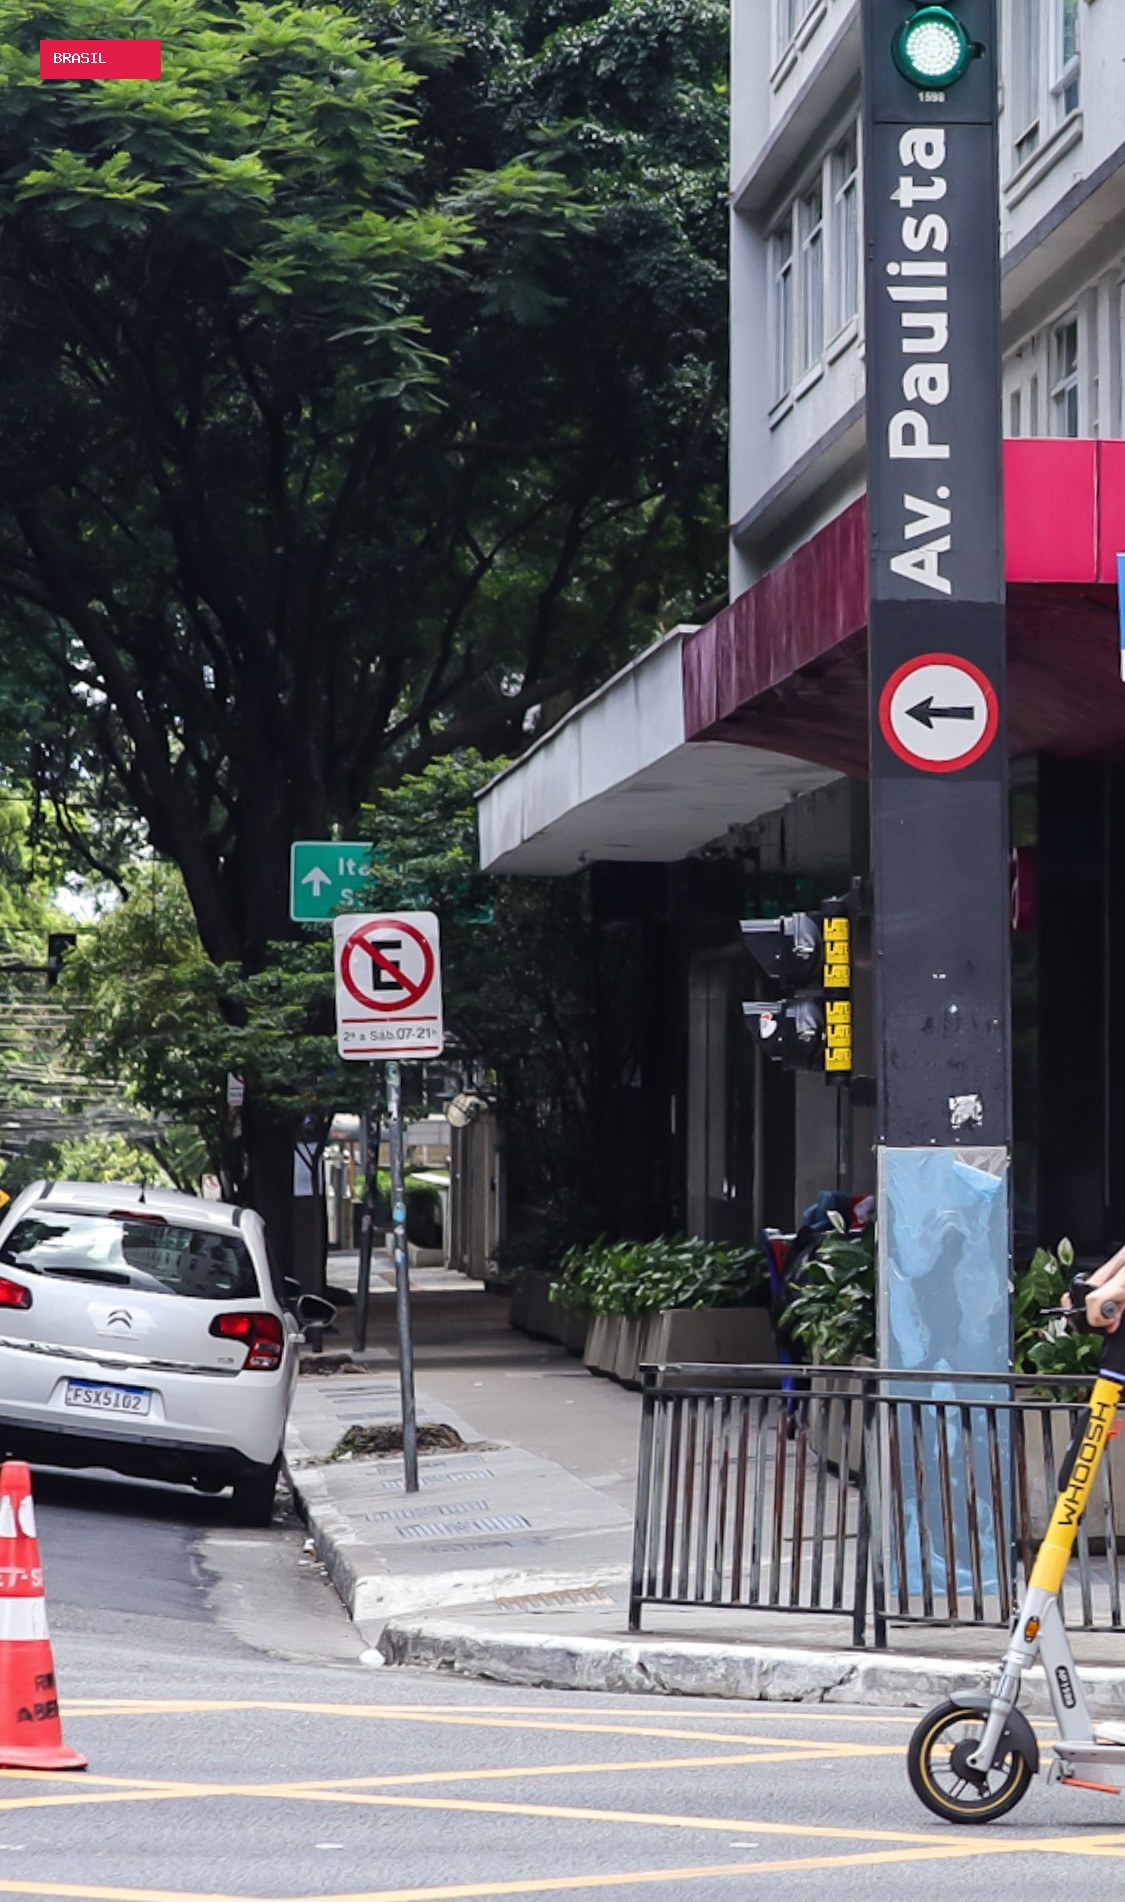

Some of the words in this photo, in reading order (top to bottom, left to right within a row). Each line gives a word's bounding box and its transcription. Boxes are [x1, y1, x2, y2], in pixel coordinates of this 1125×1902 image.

[887, 127, 951, 459] Paulista
[890, 486, 952, 595] Av.
[1057, 1400, 1115, 1526] WHOOSH
